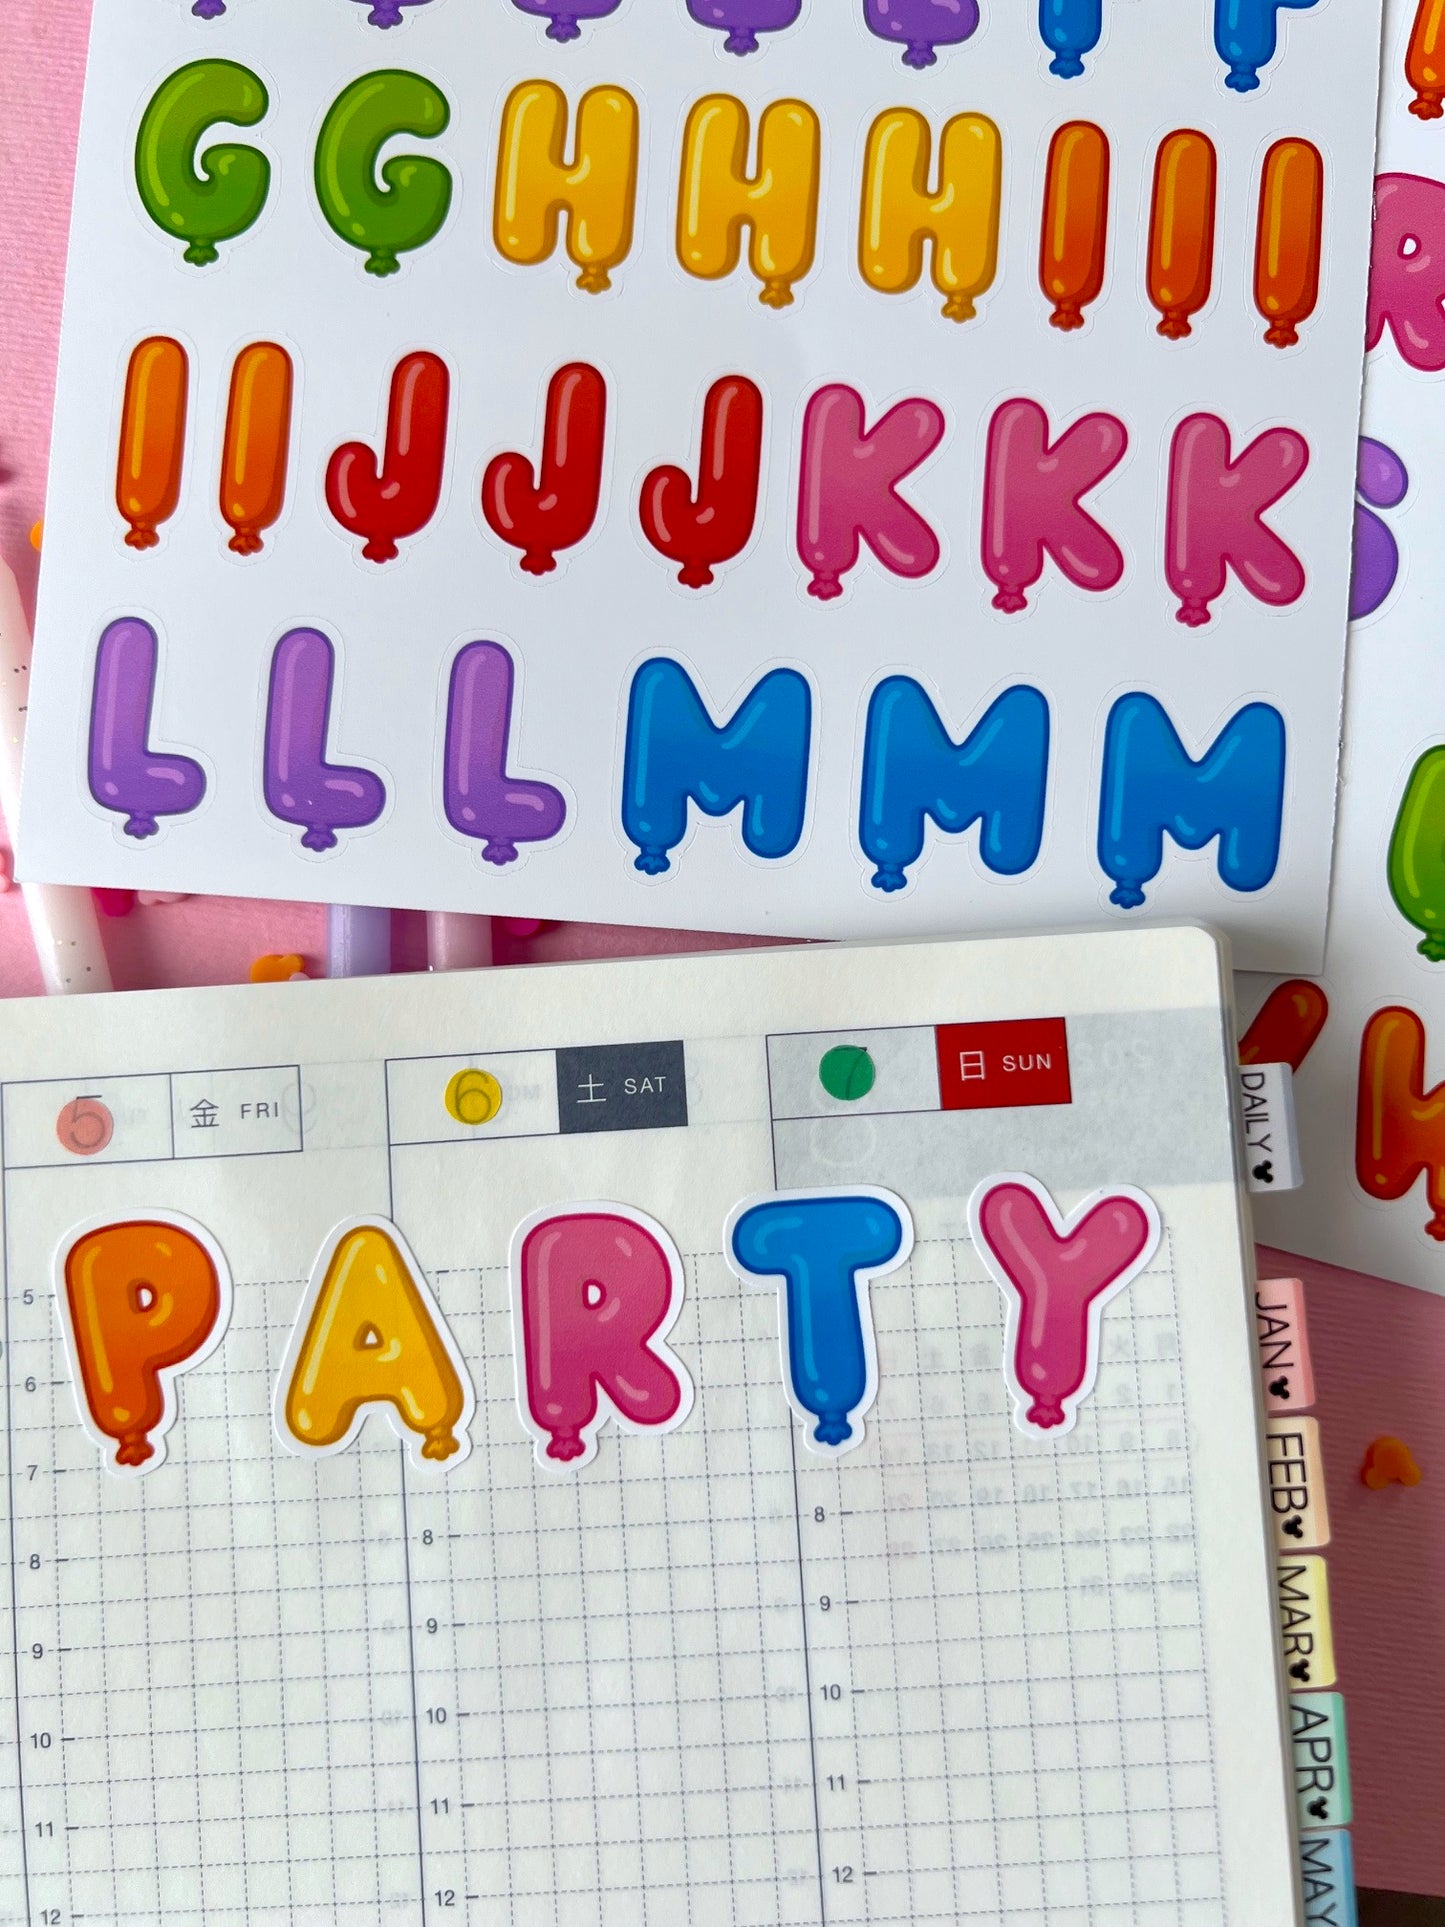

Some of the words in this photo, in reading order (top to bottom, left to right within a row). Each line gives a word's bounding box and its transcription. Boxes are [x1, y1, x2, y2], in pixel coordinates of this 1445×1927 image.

[135, 59, 270, 266] G
[314, 69, 452, 276] G
[492, 79, 639, 293] H
[676, 93, 820, 308] H
[858, 106, 1002, 322] H
[1039, 120, 1110, 330] I
[1147, 128, 1217, 339] I
[1254, 137, 1323, 348] I
[115, 336, 188, 549] I
[219, 341, 292, 555] I
[325, 351, 449, 563] J
[482, 362, 606, 575] J
[639, 375, 763, 589] J
[797, 384, 945, 600] K
[981, 398, 1128, 613] K
[1165, 413, 1309, 627] K
[89, 617, 206, 838] L
[263, 627, 386, 852] L
[443, 640, 566, 865] L
[621, 657, 812, 875] M
[859, 675, 1050, 893] M
[1097, 692, 1286, 909] M
[456, 1070, 492, 1125] 6
[577, 1074, 606, 1103] 土
[624, 1076, 666, 1094] SAT
[959, 1050, 985, 1081] 日
[1002, 1053, 1050, 1072] SUN
[70, 1094, 105, 1148] 5
[190, 1099, 219, 1129] 金
[240, 1102, 279, 1119] FRI
[1240, 1072, 1272, 1152] DAILY
[23, 1288, 34, 1304] 5
[1255, 1292, 1294, 1368] JAN
[24, 1376, 36, 1392] 6
[27, 1465, 38, 1481] 7
[1265, 1432, 1309, 1513] FEB
[422, 1529, 433, 1546] 8
[813, 1506, 825, 1523] 8
[30, 1554, 41, 1570] 8
[427, 1618, 438, 1634] 9
[819, 1595, 831, 1612] 9
[1278, 1565, 1314, 1656] MAR
[32, 1643, 43, 1659] 9
[427, 1707, 447, 1725] 10
[820, 1684, 841, 1702] 10
[30, 1732, 52, 1749] 10
[1290, 1704, 1335, 1794] APR
[431, 1798, 450, 1815] 11
[827, 1774, 846, 1791] 11
[35, 1820, 54, 1838] 11
[435, 1889, 455, 1906] 12
[832, 1866, 853, 1884] 12
[1299, 1838, 1338, 1927] MAY
[40, 1908, 61, 1926] 12
